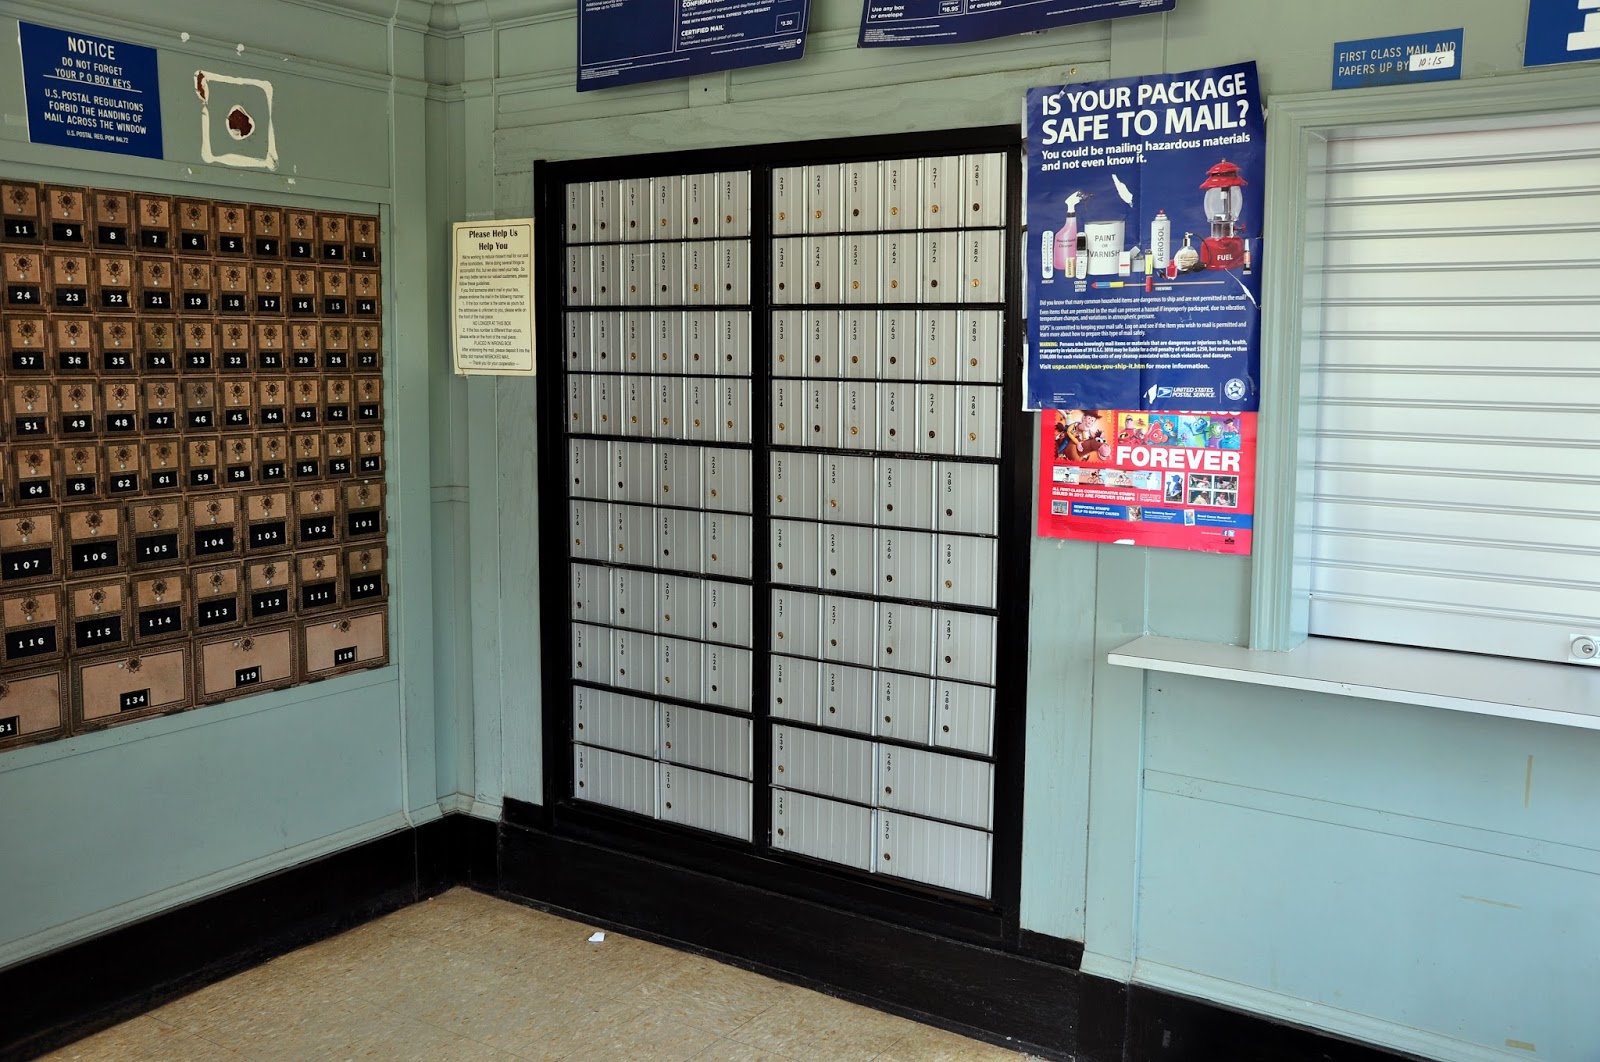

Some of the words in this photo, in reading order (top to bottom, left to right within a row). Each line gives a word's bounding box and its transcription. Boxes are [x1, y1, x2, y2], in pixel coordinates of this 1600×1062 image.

[681, 27, 709, 36] CERTIFIED
[68, 36, 115, 60] NOTICE
[1340, 49, 1366, 63] FIRST
[1371, 47, 1402, 60] CLASS
[1407, 44, 1428, 56] MAIL
[1435, 42, 1456, 52] AND
[62, 57, 72, 66] DO
[76, 59, 90, 70] NOT
[94, 62, 122, 76] FORGET
[1419, 57, 1445, 67] 10:15
[1338, 63, 1375, 76] PAPERS
[1380, 61, 1392, 72] UP
[1397, 61, 1409, 71] BY
[55, 68, 76, 79] YOUR
[79, 72, 84, 80] P
[87, 73, 92, 82] O
[95, 75, 110, 86] BOX
[113, 79, 131, 89] KEYS
[1043, 94, 1061, 116] IS
[1067, 86, 1131, 112] YOUR
[1138, 72, 1247, 106] PACKAGE
[45, 89, 61, 99] U.S.
[62, 90, 91, 104] POSTAL
[94, 96, 143, 112] REGULATIONS
[49, 101, 78, 113] FORBID
[81, 106, 95, 115] THE
[98, 109, 130, 121] HANDING
[133, 114, 142, 123] OF
[44, 112, 64, 124] MAIL
[67, 116, 97, 128] ACROSS
[100, 120, 114, 130] THE
[116, 122, 146, 134] WINDOW
[1042, 114, 1109, 145] SAFE
[1117, 109, 1158, 138] TO
[1165, 99, 1249, 134] MAIL?
[76, 131, 93, 139] POSTAL
[1042, 150, 1060, 160] You
[1061, 147, 1089, 159] could
[1090, 146, 1104, 156] be
[1106, 142, 1142, 155] mailing
[1145, 138, 1200, 151] hazardous
[1203, 132, 1250, 146] materials
[1041, 161, 1060, 172] and
[1062, 159, 1079, 170] not
[1081, 158, 1104, 168] even
[1106, 153, 1134, 166] know
[1136, 153, 1147, 163] it.
[493, 229, 507, 238] Help
[479, 243, 493, 251] Help
[1116, 446, 1240, 472] FOREVER
[308, 525, 326, 534] 102
[258, 531, 277, 540] 103
[204, 538, 224, 547] 104
[146, 545, 167, 554] 105
[84, 552, 107, 562] 106
[14, 560, 39, 570] 107
[339, 652, 353, 660] 118
[241, 672, 256, 681] 119
[127, 695, 144, 705] 134
